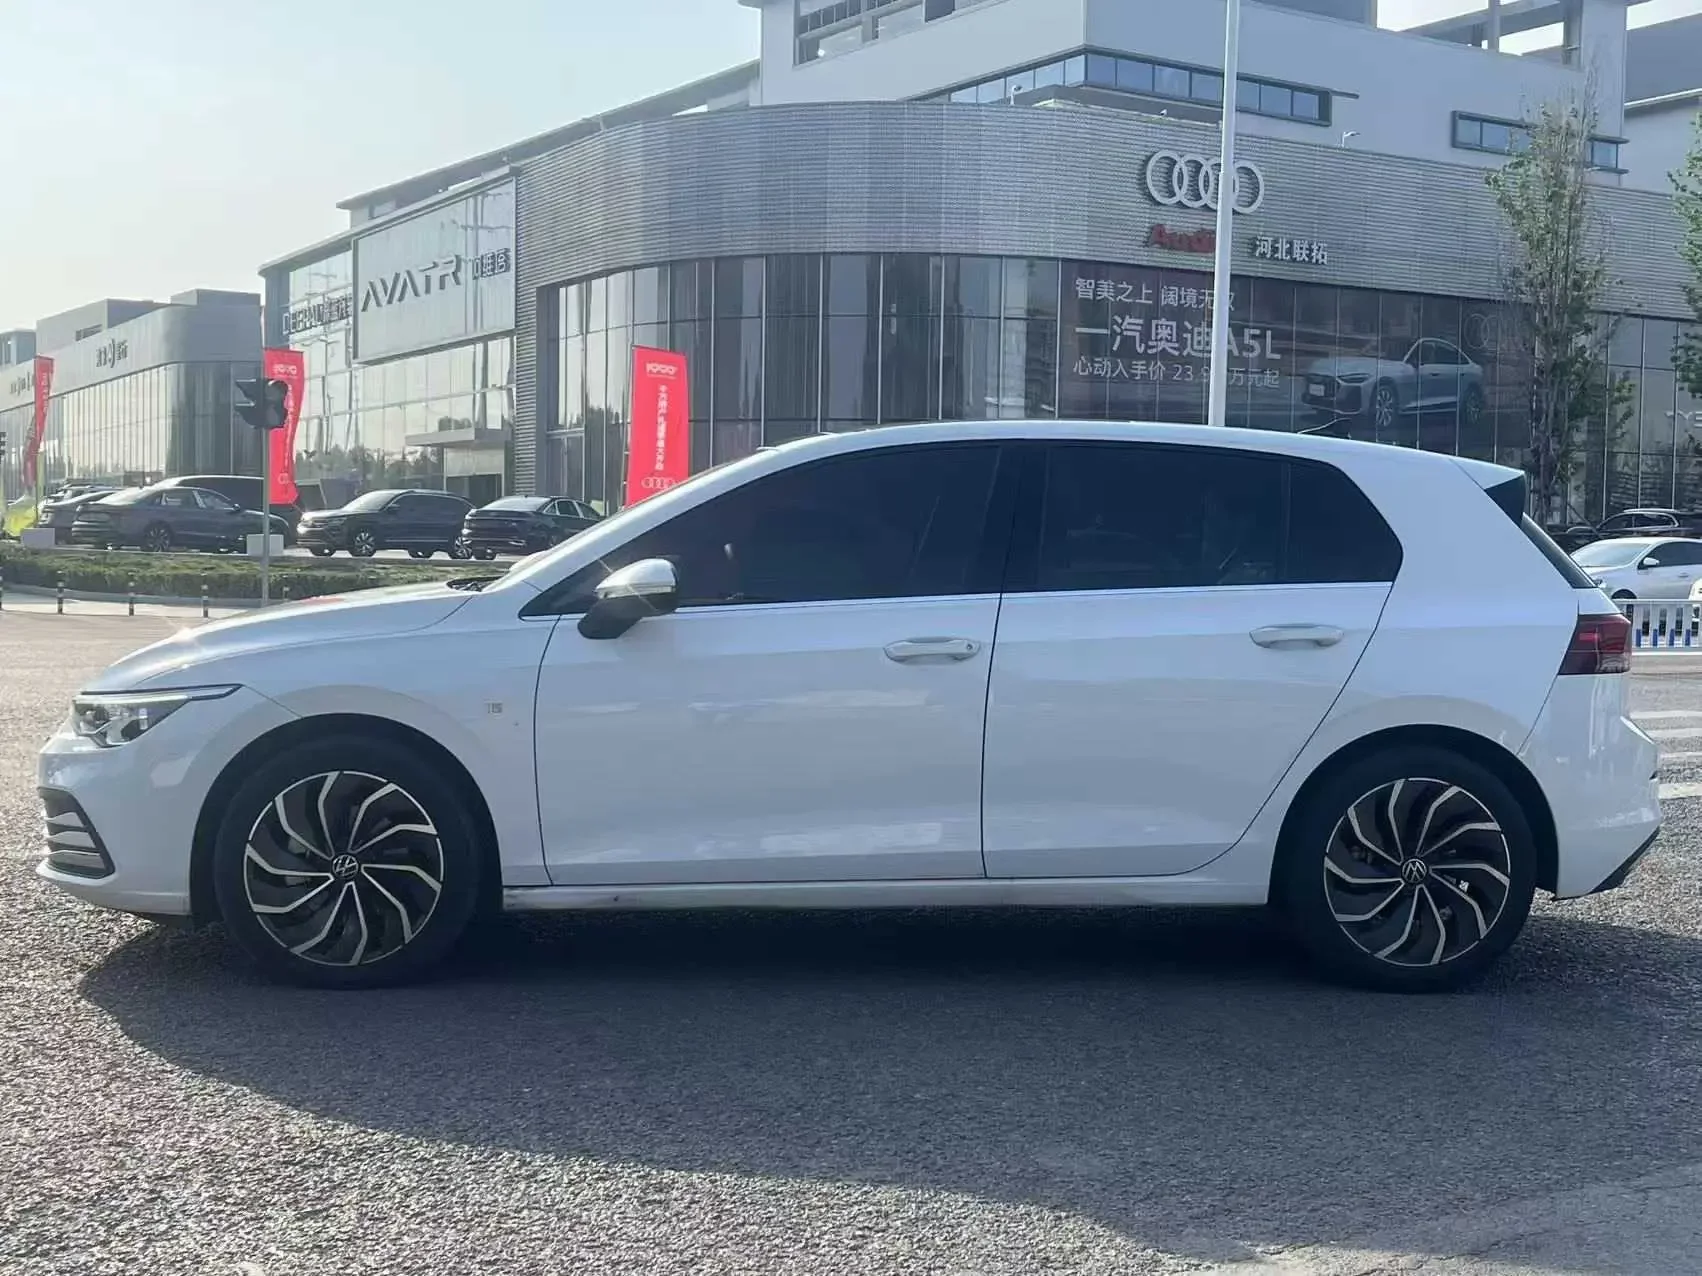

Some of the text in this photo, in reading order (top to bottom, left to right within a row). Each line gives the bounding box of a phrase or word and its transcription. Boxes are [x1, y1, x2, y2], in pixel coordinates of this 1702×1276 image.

[1255, 235, 1329, 265] 河北联拓
[361, 254, 463, 313] AVATR
[1075, 277, 1153, 304] 智美之上
[1073, 355, 1166, 382] 心动入手价
